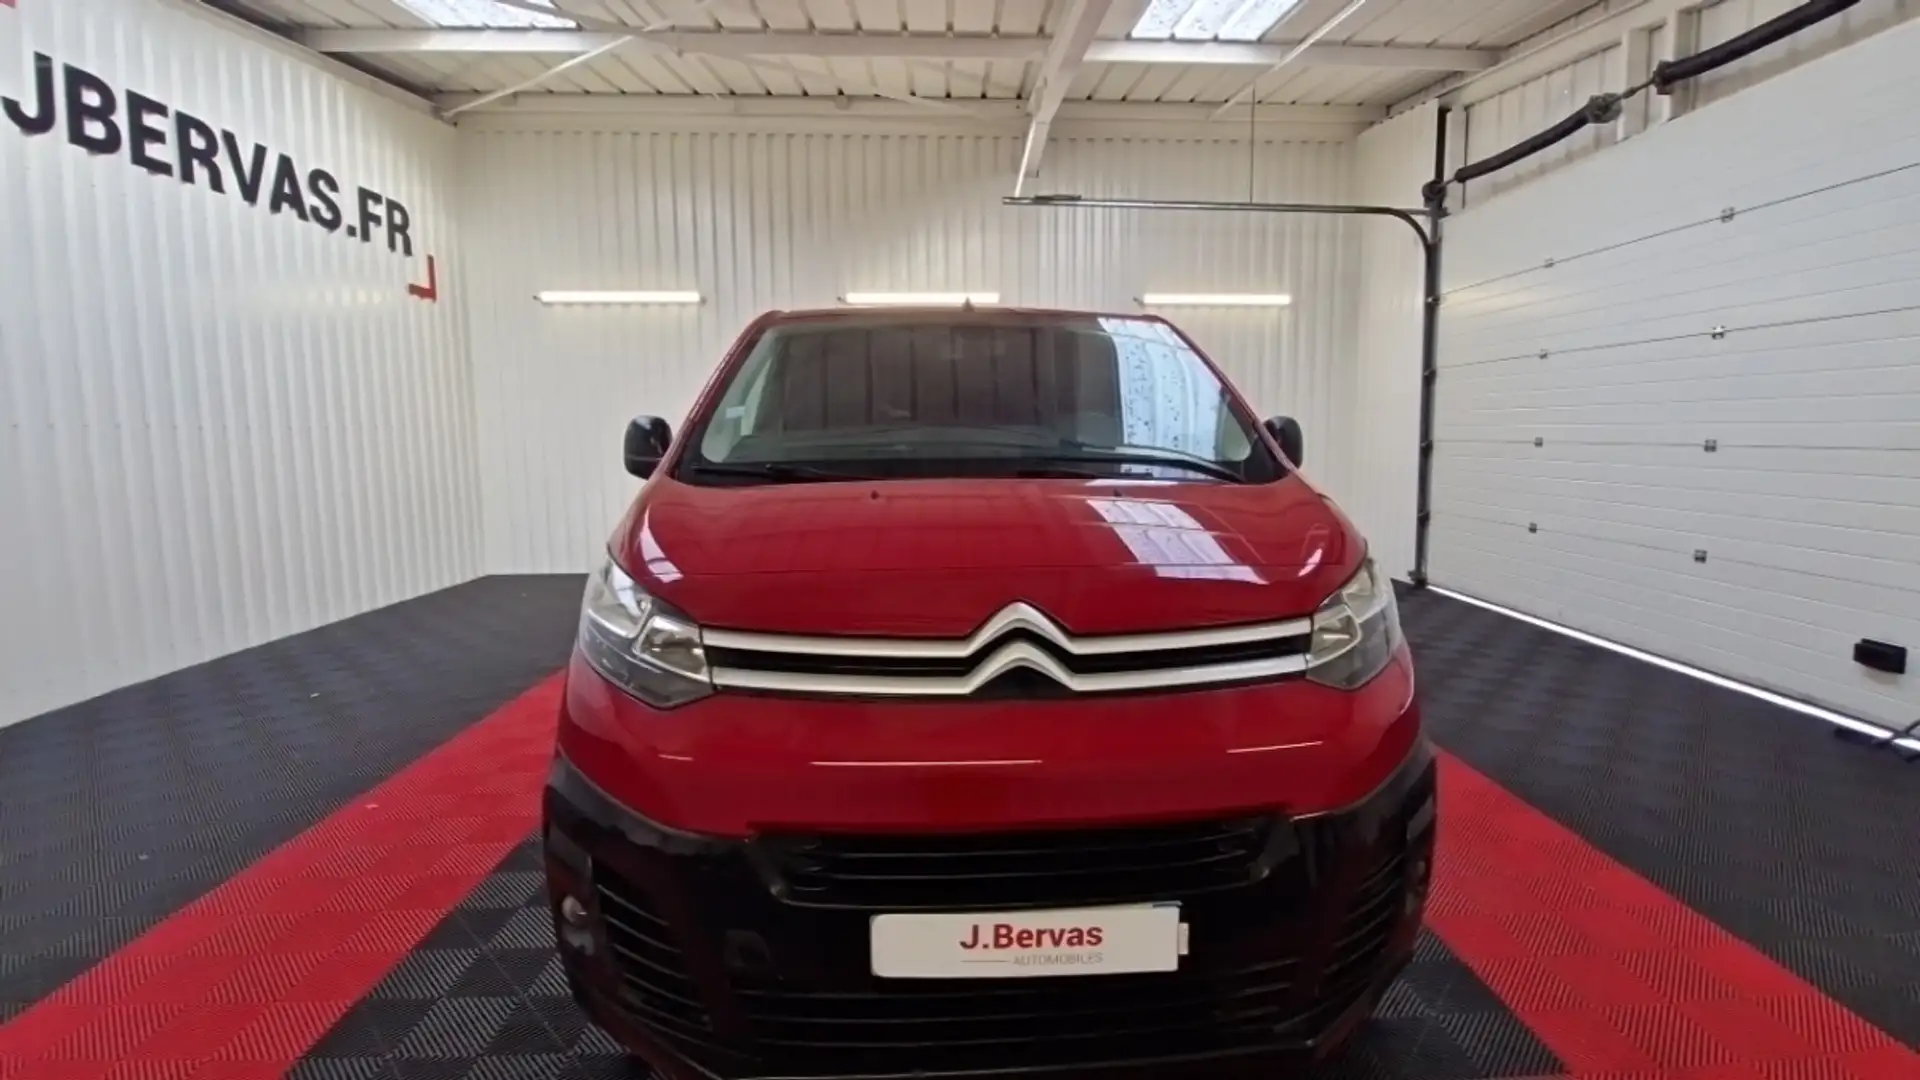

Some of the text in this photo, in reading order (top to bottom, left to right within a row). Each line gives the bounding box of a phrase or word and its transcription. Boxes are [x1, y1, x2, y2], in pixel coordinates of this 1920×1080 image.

[2, 51, 414, 257] JBERVAS.FR
[959, 923, 1104, 951] J.Bervas
[1012, 952, 1105, 967] AUTOMOBILES
